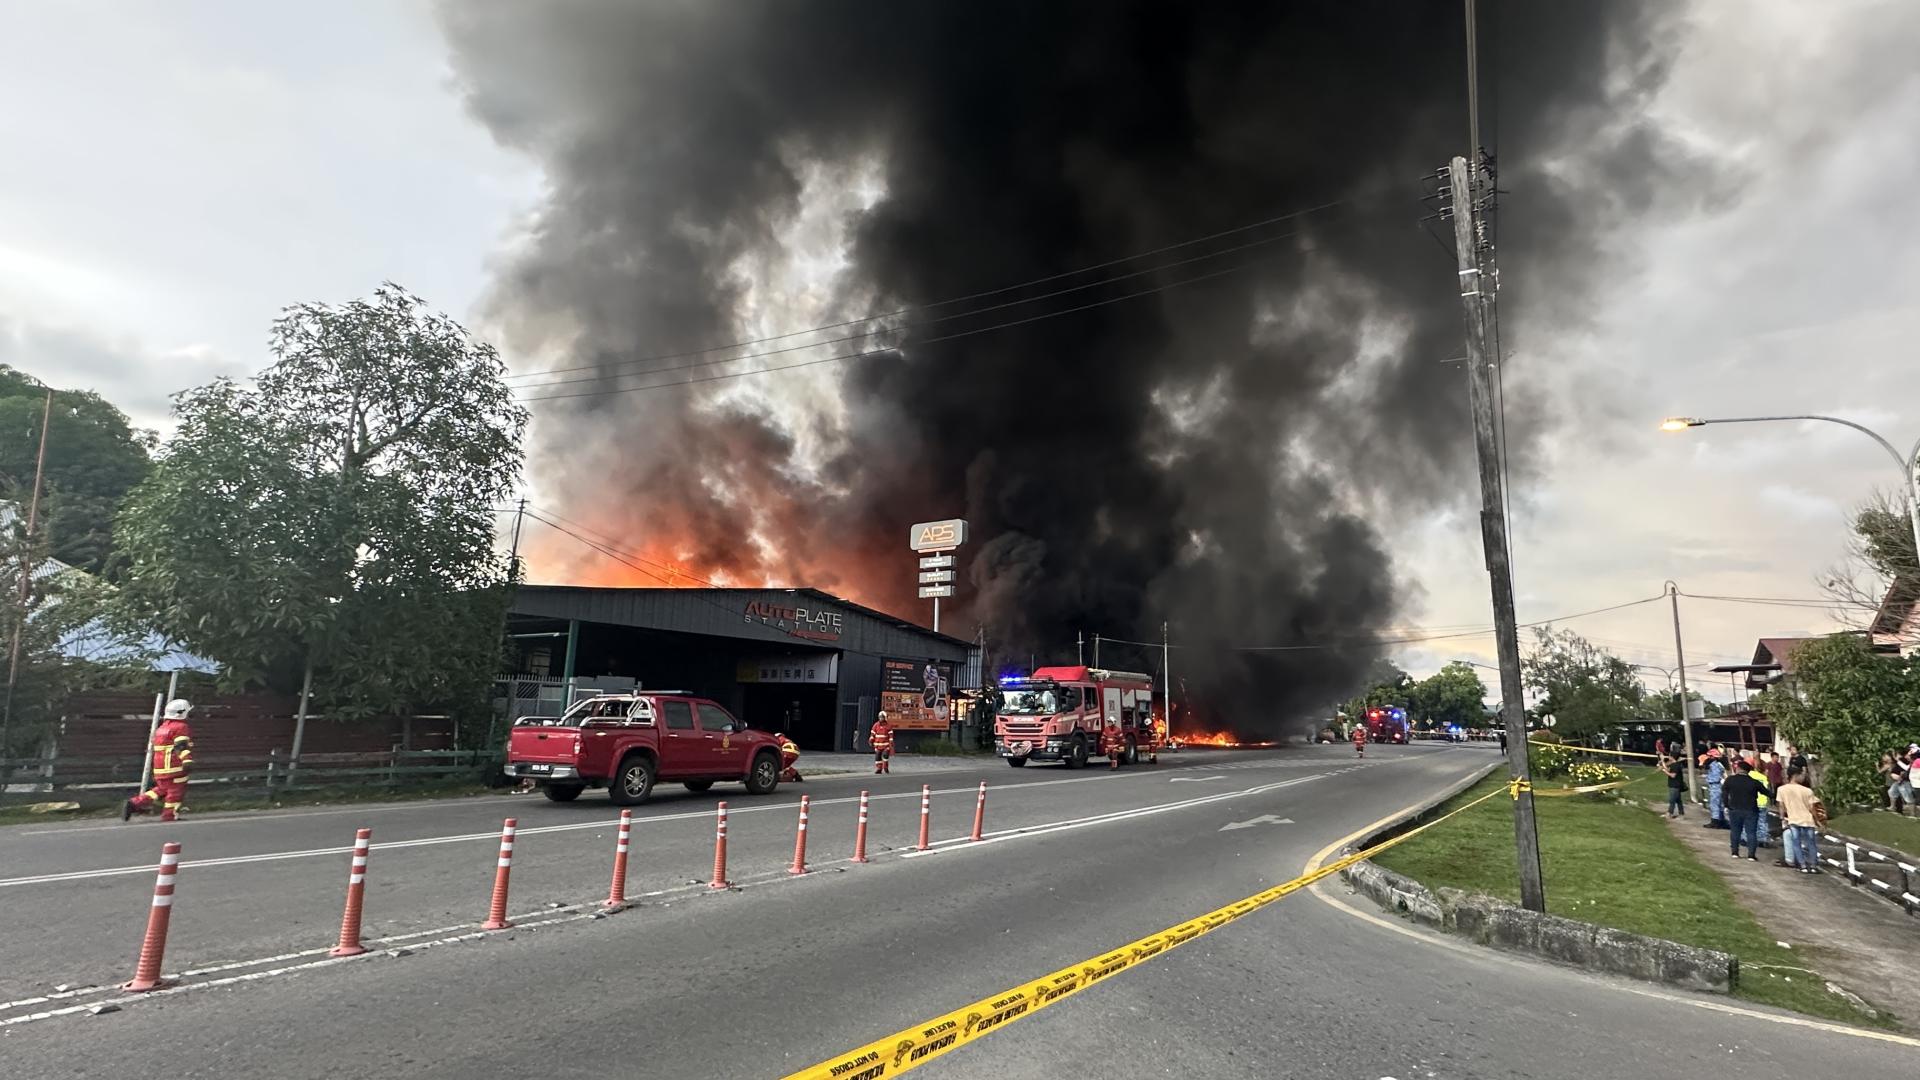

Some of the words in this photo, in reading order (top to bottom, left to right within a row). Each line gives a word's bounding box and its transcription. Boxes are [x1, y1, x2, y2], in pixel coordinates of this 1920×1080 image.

[919, 524, 955, 542] APS
[744, 614, 842, 634] STATION
[854, 1055, 869, 1068] NOT
[868, 1051, 879, 1061] DO
[829, 1061, 855, 1077] CROSS
